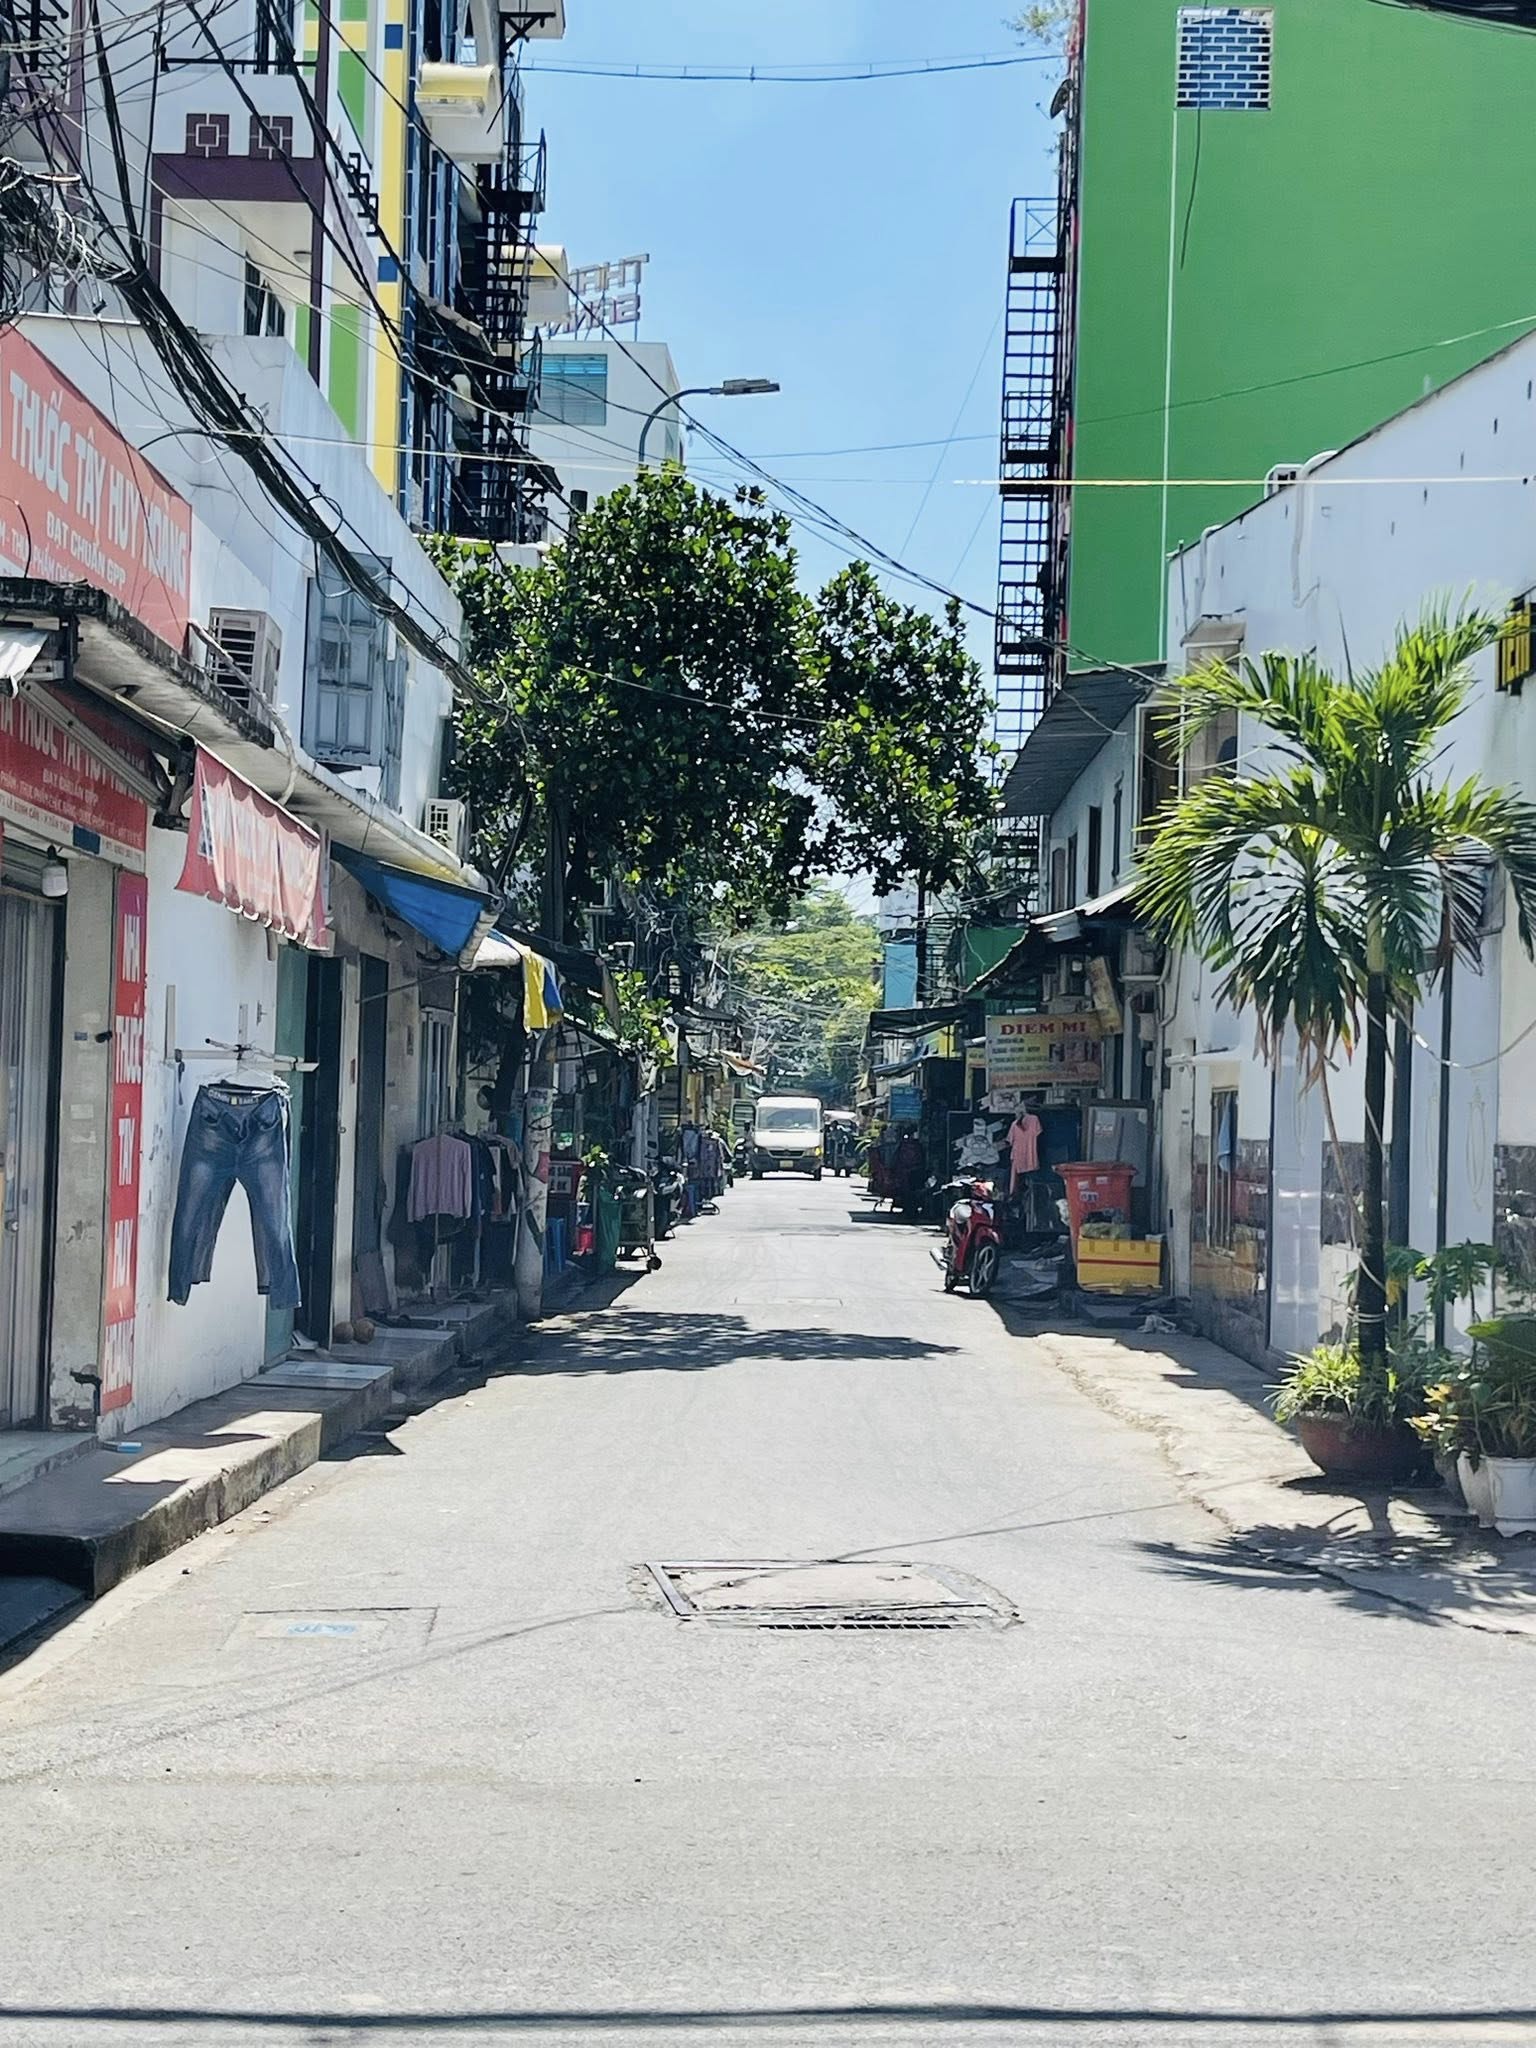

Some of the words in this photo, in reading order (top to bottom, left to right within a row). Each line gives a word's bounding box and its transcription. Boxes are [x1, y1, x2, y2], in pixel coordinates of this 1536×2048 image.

[10, 369, 71, 504] THUỐC
[75, 426, 106, 530] TÂY
[108, 464, 139, 559] HUY
[106, 558, 126, 591] GPP
